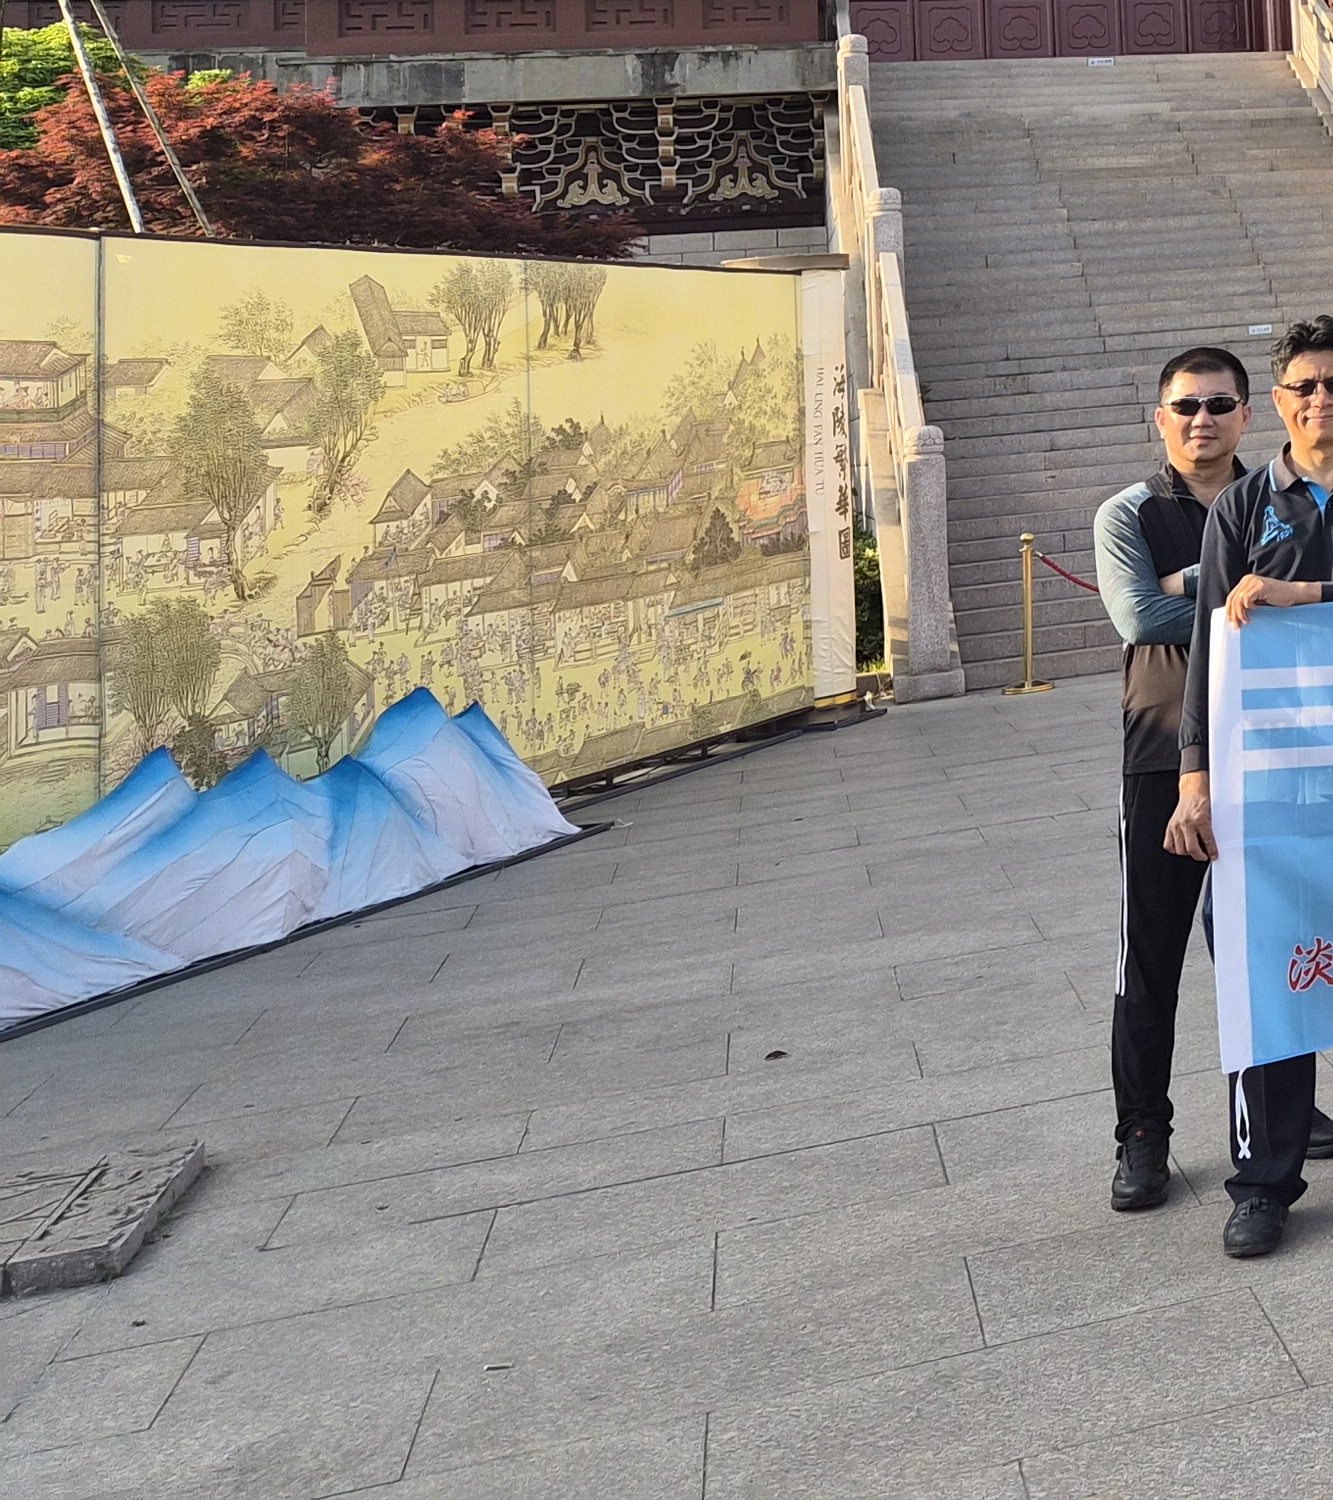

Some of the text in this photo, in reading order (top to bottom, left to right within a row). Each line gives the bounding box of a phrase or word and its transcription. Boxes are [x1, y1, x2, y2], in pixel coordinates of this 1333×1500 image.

[813, 366, 825, 496] HAI LING FAN HUA TU
